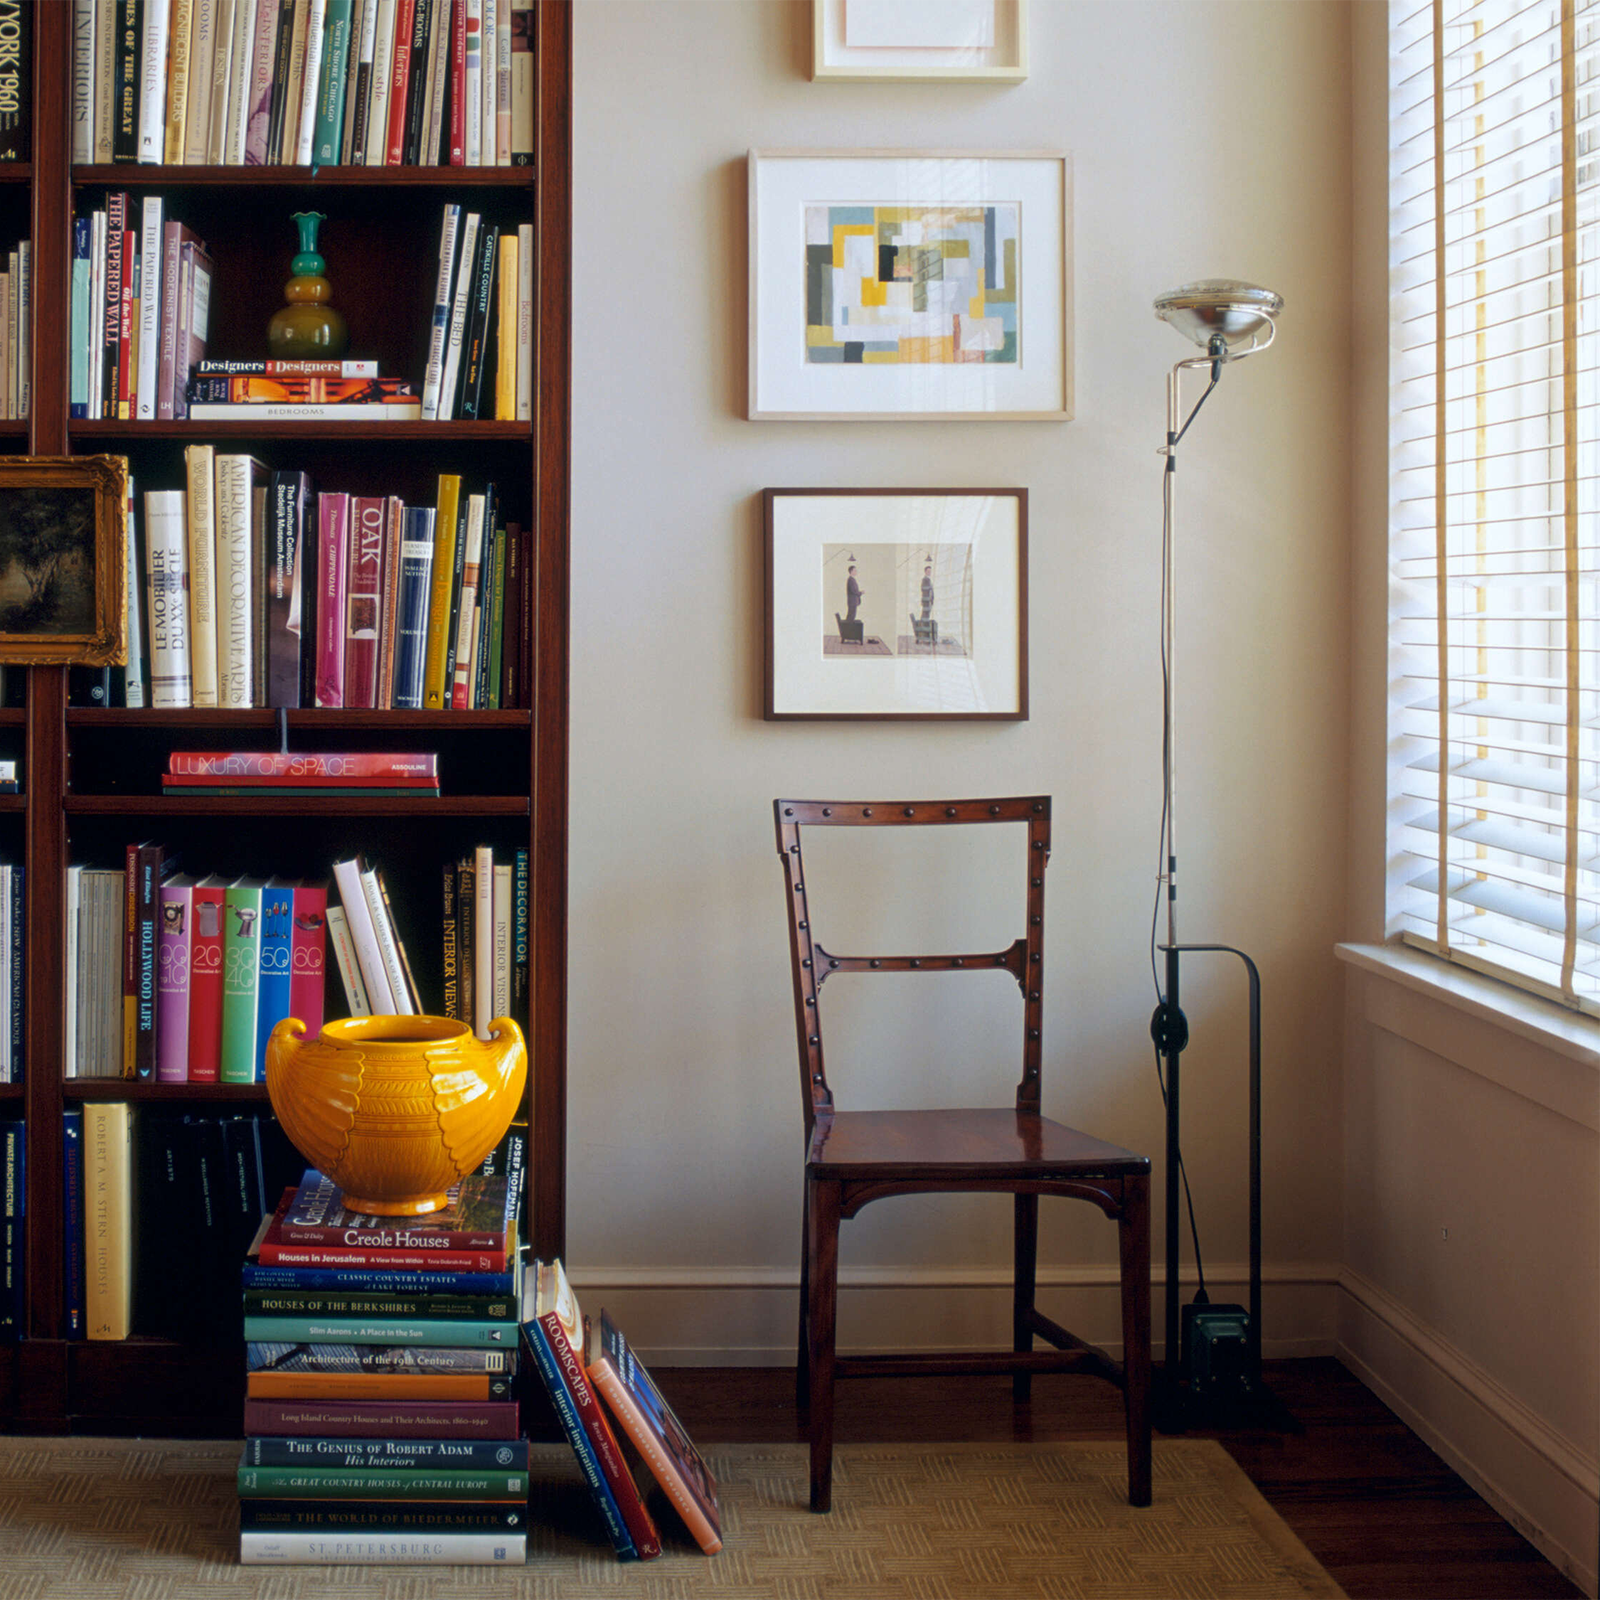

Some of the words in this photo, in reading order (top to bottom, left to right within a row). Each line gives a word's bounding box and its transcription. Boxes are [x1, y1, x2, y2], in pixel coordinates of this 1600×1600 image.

[0, 10, 20, 67] YORK
[125, 30, 136, 50] OF
[334, 19, 344, 46] NORTH
[456, 28, 464, 64] hardware
[75, 10, 92, 123] INTERIORS
[123, 54, 135, 83] THE
[145, 25, 159, 92] LIBRARIES
[214, 48, 227, 86] DESIGN
[256, 20, 273, 92] INTERIORS
[331, 49, 341, 78] SHORE
[395, 45, 409, 87] Interiors
[500, 38, 509, 64] Color
[0, 69, 20, 112] 1960
[172, 72, 186, 122] BUILDERS
[328, 81, 338, 122] CHICAGO
[499, 67, 509, 102] Palettes
[122, 86, 134, 134] GREAT
[109, 193, 122, 228] THE
[147, 223, 158, 249] THE
[167, 237, 177, 257] THE
[483, 235, 495, 272] CATSKILLS
[106, 229, 122, 302] PAPERED
[144, 251, 157, 302] PAPERED
[121, 286, 132, 302] Off
[164, 260, 176, 319] MODERNIST
[455, 290, 469, 319] THE
[479, 273, 491, 313] COUNTRY
[105, 304, 120, 347] WALL
[122, 302, 131, 317] the
[142, 304, 155, 335] WALL
[520, 300, 532, 345] Bedrooms
[121, 317, 132, 339] Wall
[163, 322, 174, 361] TEXTILE
[450, 320, 465, 347] BED
[200, 360, 265, 379] Designers
[275, 360, 341, 378] Designers
[267, 408, 325, 416] BEDROOMS
[193, 460, 208, 522] WORLD
[218, 460, 229, 487] Bishop
[220, 488, 229, 503] and
[230, 460, 246, 544] AMERICAN
[276, 484, 286, 518] Stedelijk
[286, 484, 295, 500] The
[220, 505, 229, 540] Coblentz
[276, 519, 285, 552] Museum
[285, 501, 295, 536] Furniture
[329, 509, 338, 539] Thomas
[360, 507, 382, 565] OAK
[352, 508, 361, 565] FURNITURE
[285, 537, 295, 576] Collection
[328, 544, 337, 598] CHIPPENDALE
[438, 539, 448, 574] Archive
[152, 550, 168, 629] MOBILIER
[194, 527, 210, 623] FURNITURE
[276, 553, 285, 598] Amsterdam
[230, 549, 246, 656] DECORATIVE
[431, 580, 450, 625] Design
[154, 634, 167, 651] LE
[171, 626, 184, 650] DU
[429, 632, 441, 685] Decoration
[220, 672, 230, 702] Abrams
[230, 660, 246, 704] ARTS
[176, 756, 253, 775] LUXURY
[258, 757, 287, 776] OF
[290, 758, 355, 776] SPACE
[517, 853, 528, 878] THE
[12, 926, 20, 948] NEW
[365, 880, 377, 905] HOUSE
[374, 914, 388, 942] GARDEN
[381, 944, 394, 964] BOOK
[462, 906, 471, 946] INTERIOR
[516, 880, 528, 963] DECORATOR
[141, 921, 153, 999] HOLLYWOOD
[442, 919, 456, 977] INTERIOR
[496, 921, 506, 972] INTERIOR
[12, 950, 20, 997] AMERICAN
[496, 977, 506, 1018] VISIONS
[12, 999, 20, 1046] GLAMOUR
[141, 1002, 153, 1031] LIFE
[6, 1133, 14, 1162] PRIVATE
[96, 1115, 106, 1163] ROBERT
[513, 1137, 523, 1169] JOSEF
[97, 1167, 106, 1176] A.
[97, 1181, 106, 1196] M.
[6, 1162, 14, 1217] ARCHITECTURE
[97, 1200, 107, 1238] STERN
[344, 1230, 393, 1247] Creole
[395, 1231, 450, 1248] Houses
[97, 1247, 108, 1295] HOUSES
[278, 1253, 309, 1262] Houses
[311, 1253, 321, 1262] in
[322, 1254, 366, 1263] Jerusalem
[337, 1274, 370, 1283] CLASSIC
[373, 1274, 417, 1283] COUNTRY
[420, 1275, 457, 1283] ESTATES
[261, 1299, 305, 1310] HOUSES
[308, 1300, 323, 1311] OF
[326, 1301, 347, 1311] THE
[350, 1301, 416, 1313] BERKSHIRES
[309, 1326, 325, 1335] Slim
[326, 1327, 352, 1336] Aarons
[359, 1328, 365, 1336] A
[366, 1328, 385, 1337] Place
[394, 1329, 407, 1338] the
[408, 1329, 423, 1338] Sun
[301, 1353, 361, 1365] Architecture
[362, 1354, 373, 1365] of
[374, 1355, 391, 1366] the
[416, 1356, 455, 1367] Century
[543, 1315, 592, 1407] ROOMSCAPES
[281, 1412, 300, 1423] Long
[301, 1413, 322, 1422] Island
[323, 1414, 352, 1424] Country
[380, 1416, 393, 1424] and
[395, 1416, 413, 1424] Their
[591, 1421, 605, 1441] Renzo
[286, 1441, 313, 1453] THE
[316, 1441, 362, 1454] GENIUS
[367, 1446, 381, 1454] OF
[385, 1443, 433, 1455] ROBERT
[437, 1443, 474, 1456] ADAM
[555, 1389, 574, 1428] interior
[571, 1429, 601, 1488] inspirations
[344, 1454, 365, 1466] His
[367, 1455, 416, 1467] Interiors
[290, 1478, 320, 1487] GREAT
[322, 1478, 365, 1488] COUNTRY
[367, 1479, 401, 1488] HOUSES
[412, 1480, 452, 1489] CENTRAL
[455, 1480, 489, 1490] EUROPE
[295, 1513, 322, 1524] THE
[327, 1513, 379, 1525] WORLD
[382, 1514, 399, 1525] OF
[403, 1514, 500, 1526] BIEDERMEIER
[335, 1542, 444, 1556] PETERSBURG
